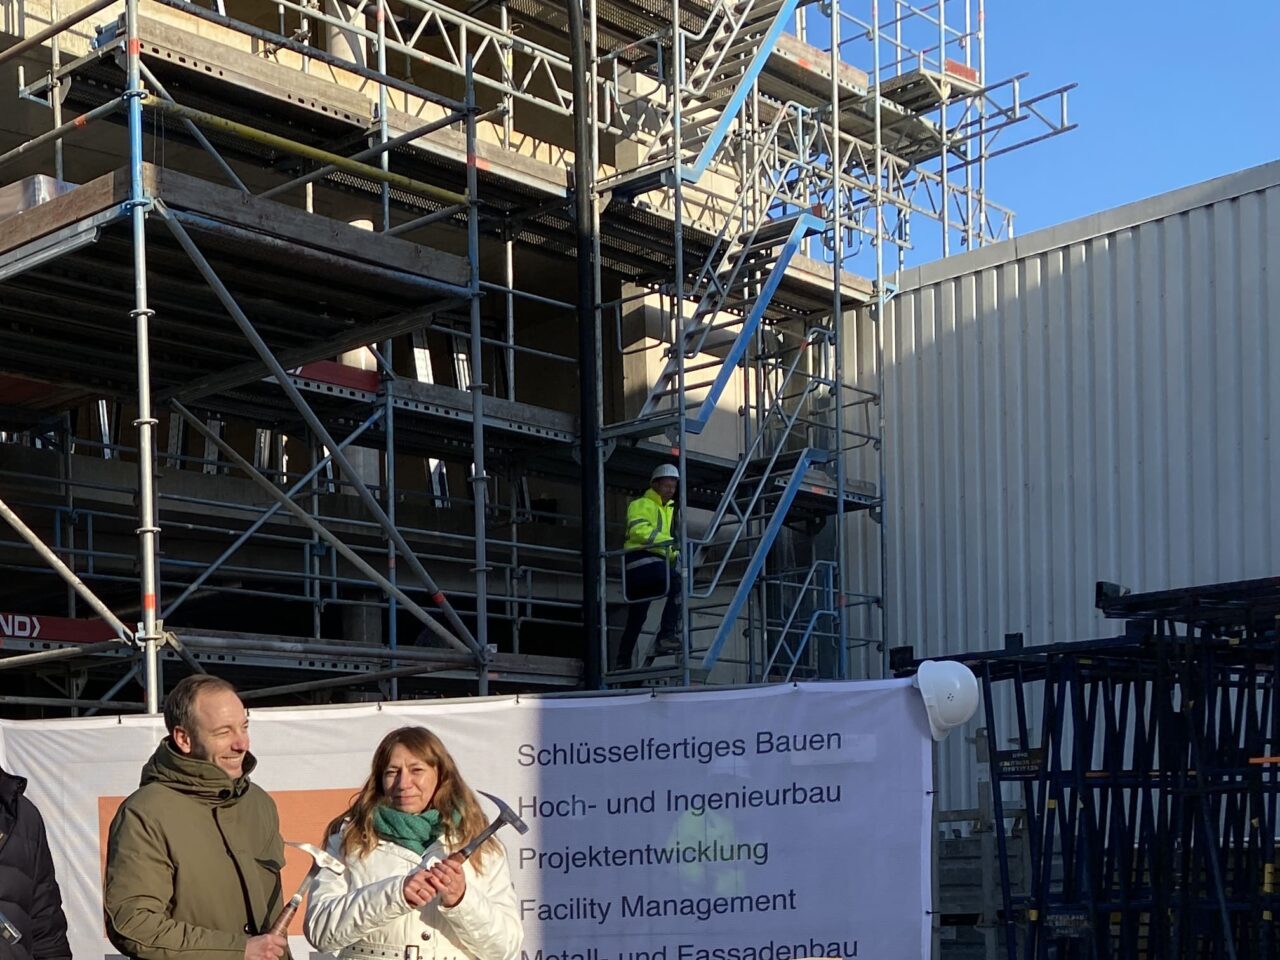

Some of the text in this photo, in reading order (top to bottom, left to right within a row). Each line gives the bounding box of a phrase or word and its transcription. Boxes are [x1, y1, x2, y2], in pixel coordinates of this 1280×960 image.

[517, 731, 842, 767] Schlüsselfertiges Bauen
[518, 782, 842, 818] Hoch- und Ingenieurbau
[519, 840, 769, 874] Projektentwicklung
[520, 889, 797, 925] Facility Management
